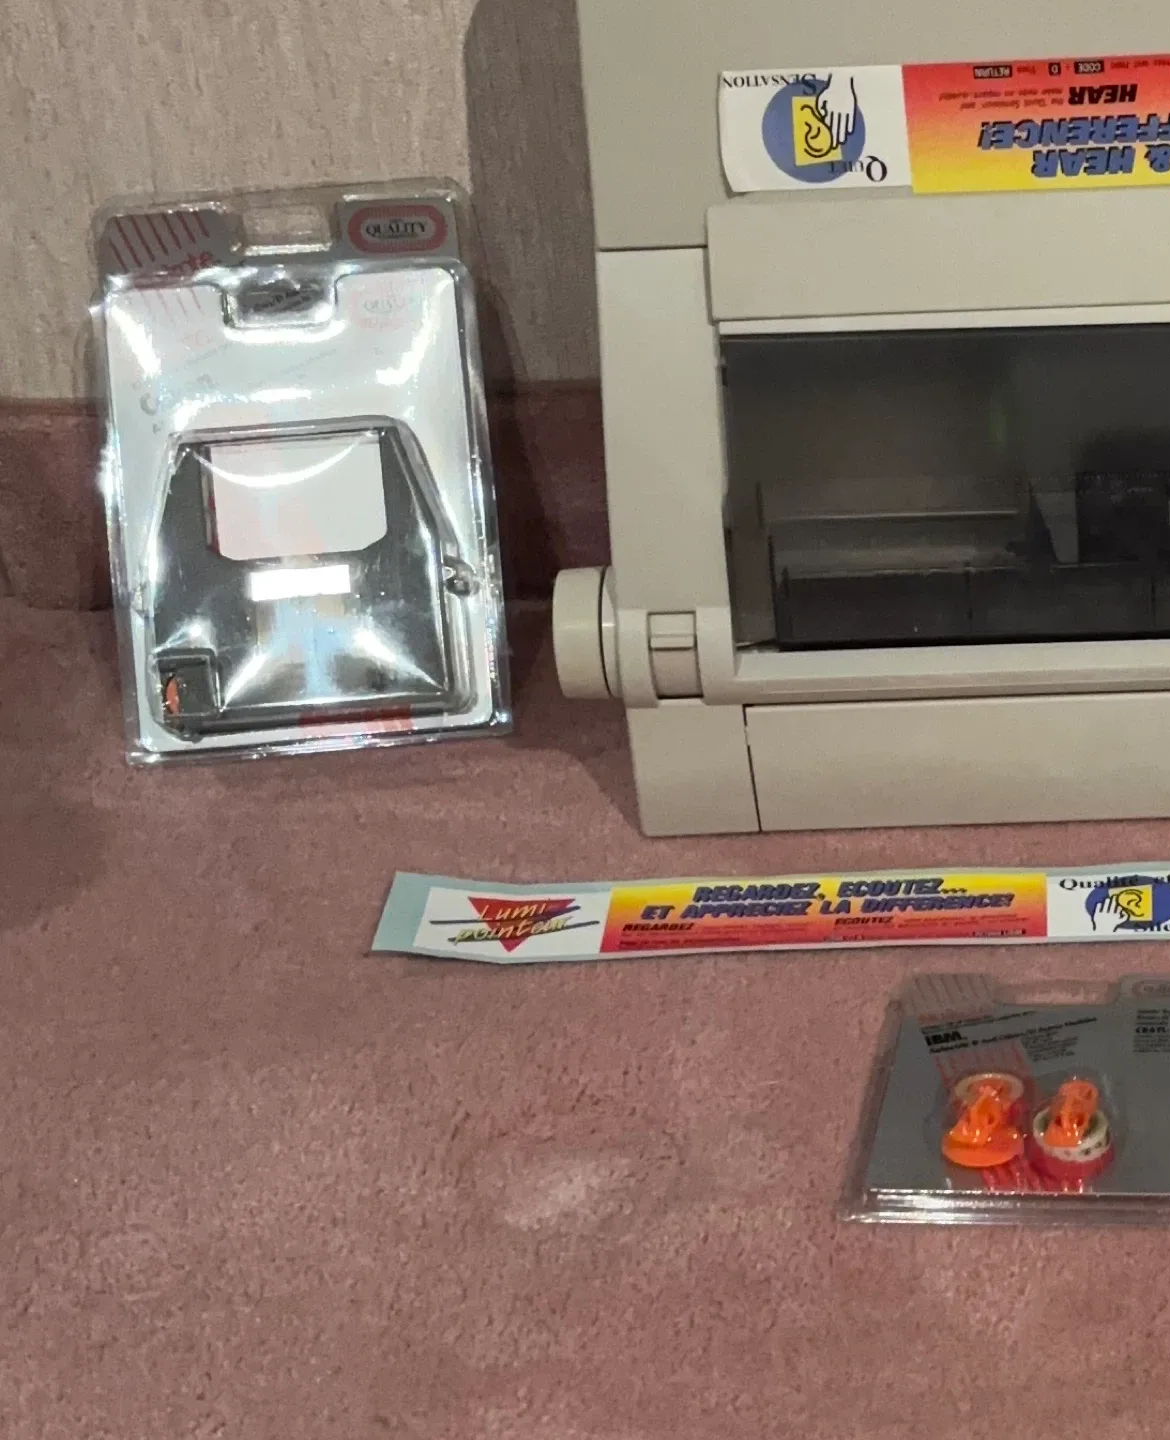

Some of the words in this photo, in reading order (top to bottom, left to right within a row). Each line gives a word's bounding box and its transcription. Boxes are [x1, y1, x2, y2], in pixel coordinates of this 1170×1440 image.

[974, 66, 1012, 78] RETURN
[1077, 61, 1103, 74] CODE
[1068, 84, 1137, 106] HEAR
[1031, 145, 1137, 178] HEAR
[365, 222, 428, 237] QUALITY
[476, 898, 547, 922] Lumi
[641, 904, 675, 920] ET
[679, 901, 813, 919] APPRECIEZ
[820, 899, 851, 914] LA
